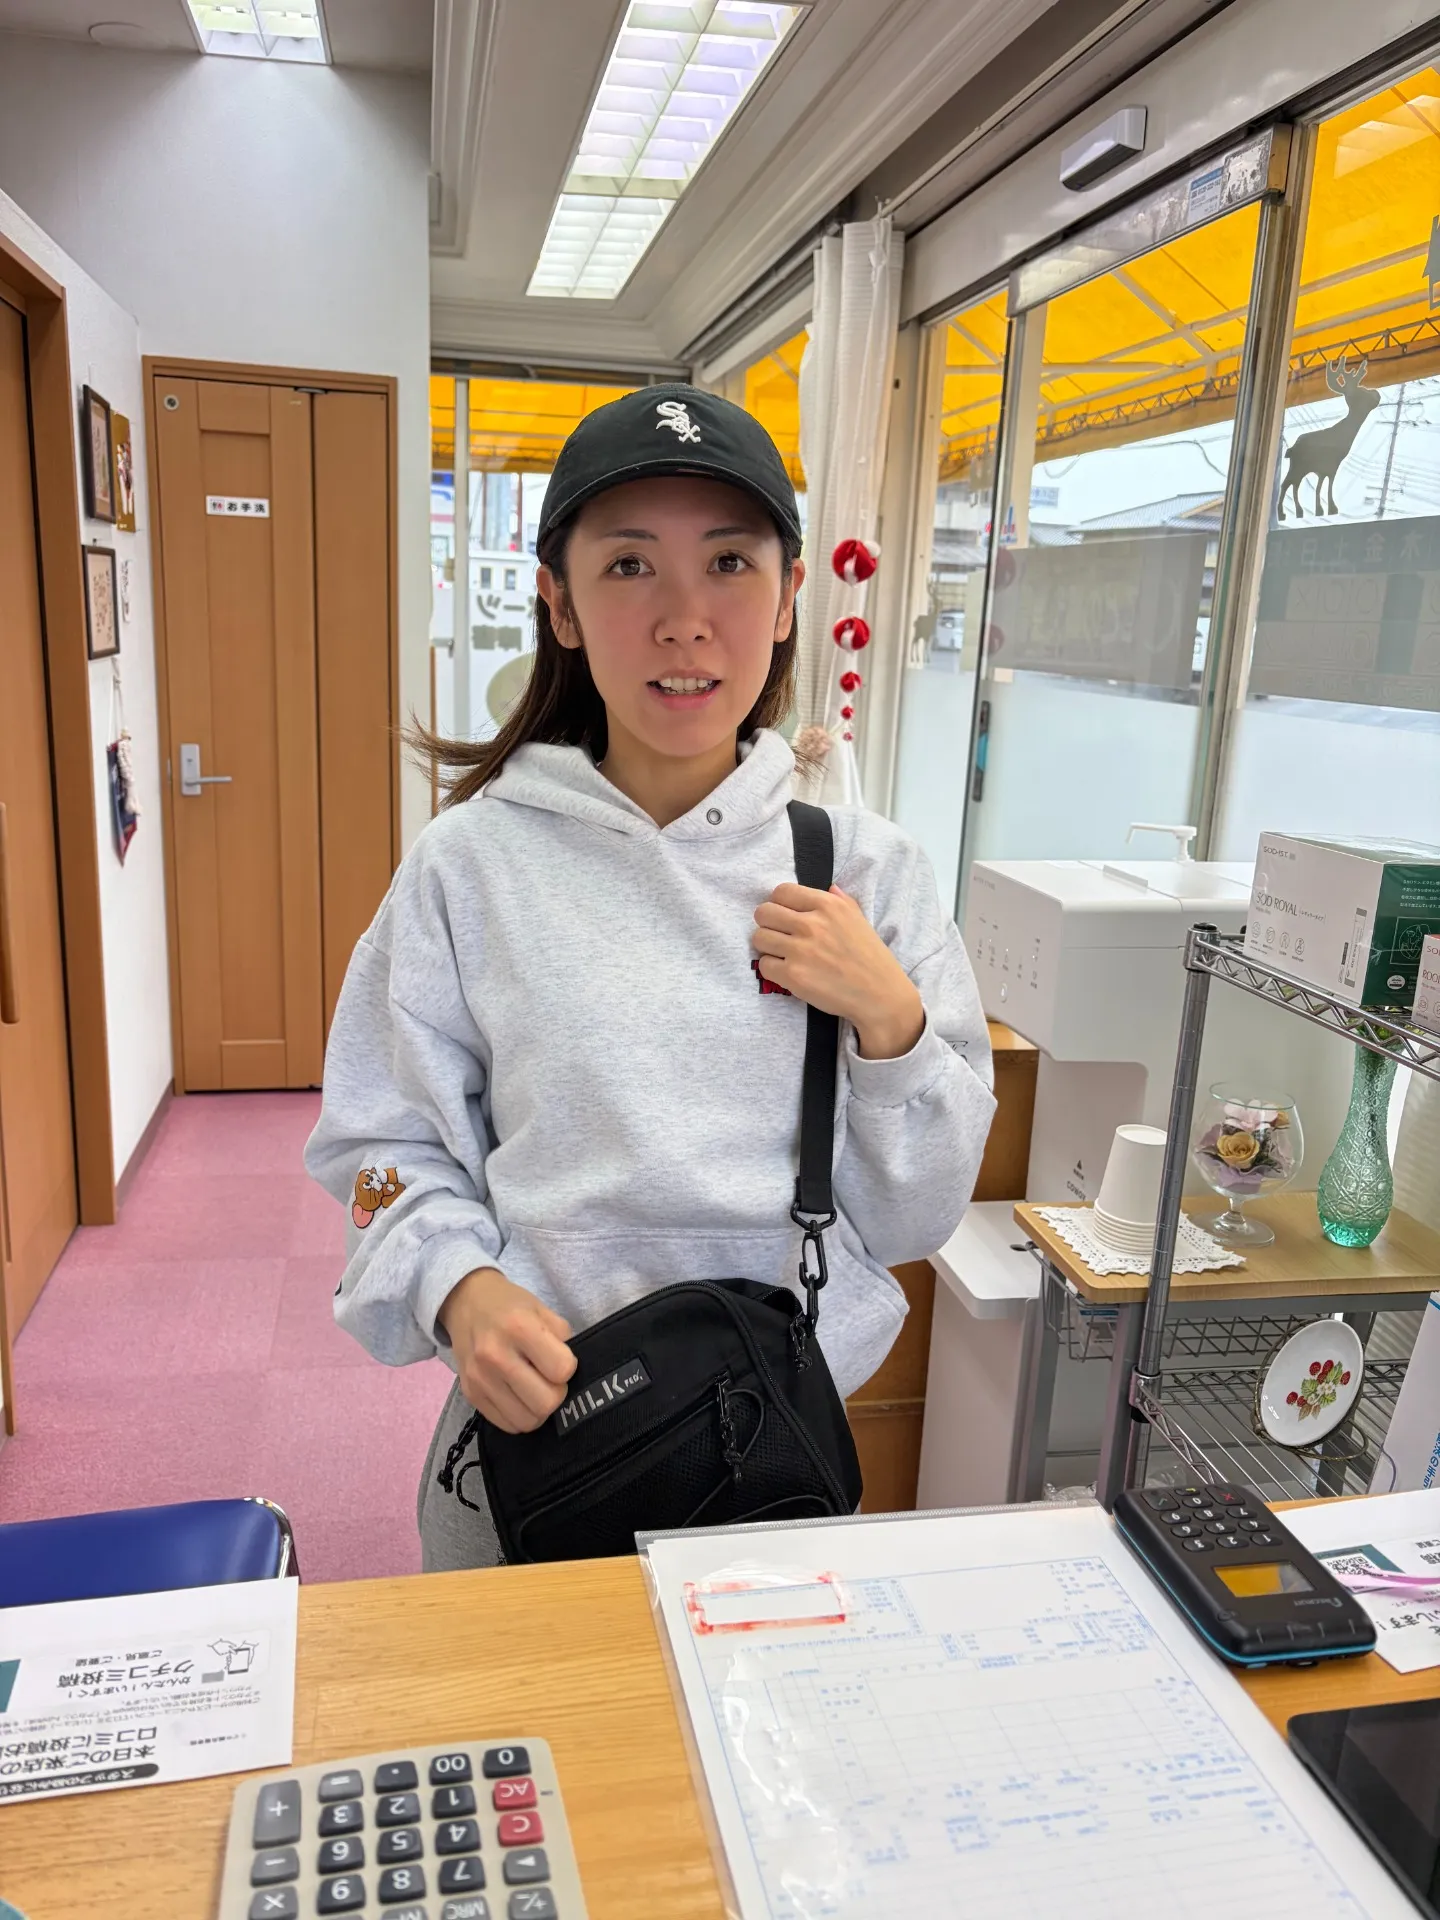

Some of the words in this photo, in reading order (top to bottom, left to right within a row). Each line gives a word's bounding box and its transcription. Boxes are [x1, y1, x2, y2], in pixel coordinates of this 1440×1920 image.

[1274, 897, 1298, 917] ROYAL
[56, 1659, 194, 1688] クチコミ投稿
[498, 1749, 513, 1765] 0
[449, 1789, 460, 1806] 1
[501, 1780, 529, 1798] AC
[333, 1806, 348, 1825] 3
[390, 1798, 405, 1815] 2
[511, 1816, 531, 1833] C
[391, 1832, 407, 1850] 5
[449, 1825, 467, 1843] 4
[332, 1841, 349, 1862] 6
[392, 1870, 411, 1890] 8
[453, 1861, 471, 1881] 7
[332, 1880, 350, 1900] 9
